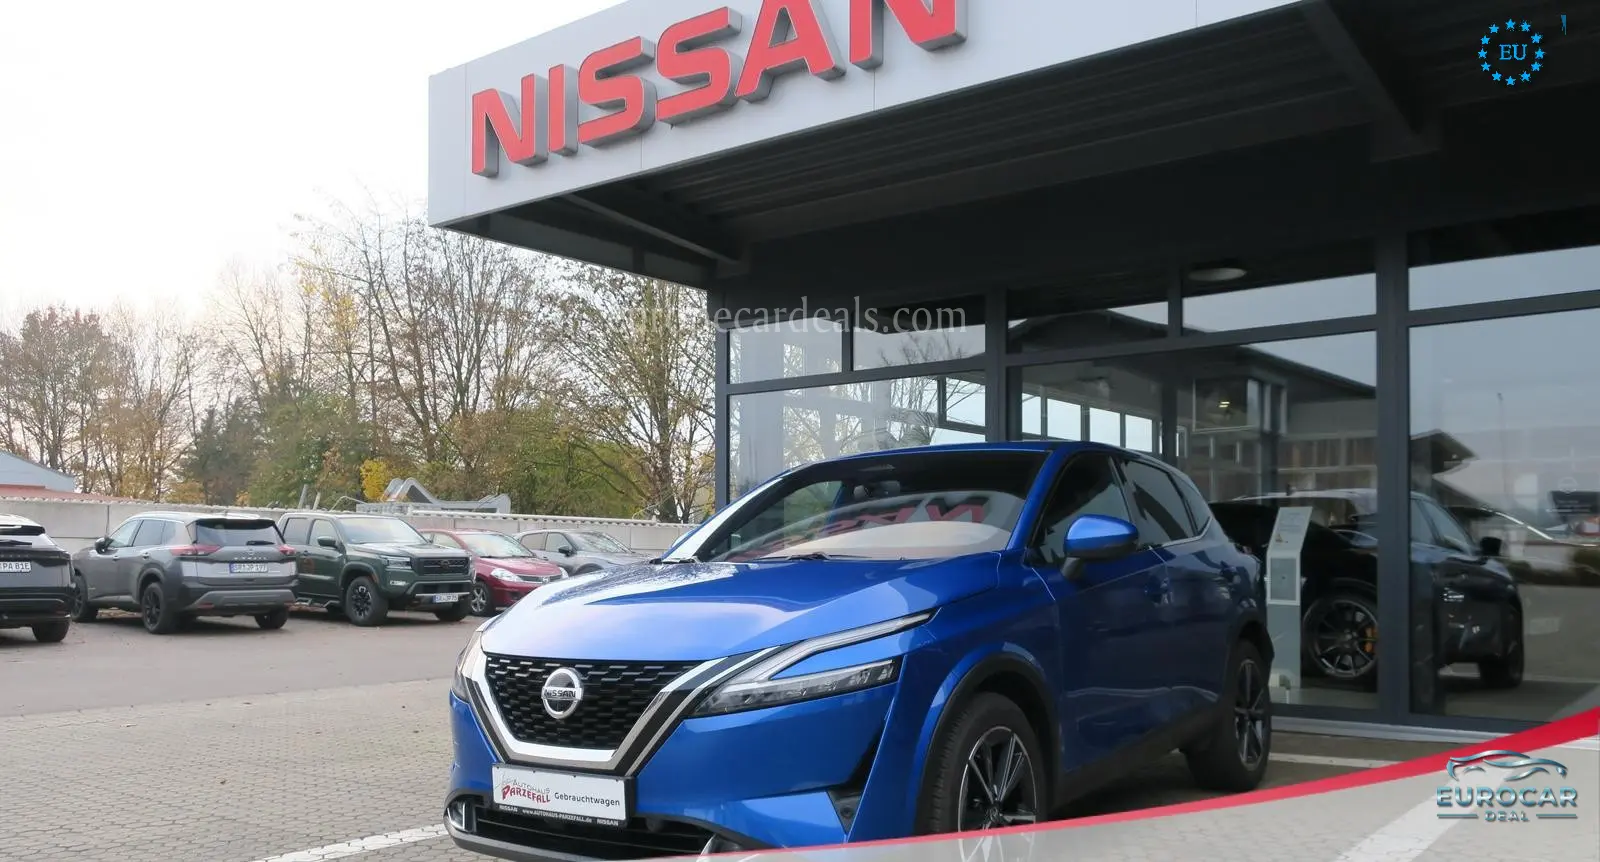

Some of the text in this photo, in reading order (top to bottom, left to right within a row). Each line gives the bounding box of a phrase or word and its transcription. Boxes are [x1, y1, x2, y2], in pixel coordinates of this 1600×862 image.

[471, 0, 966, 178] NISSAN
[543, 688, 577, 698] NISSAN
[502, 784, 620, 807] PARZEFALL Gebrauchtwagen
